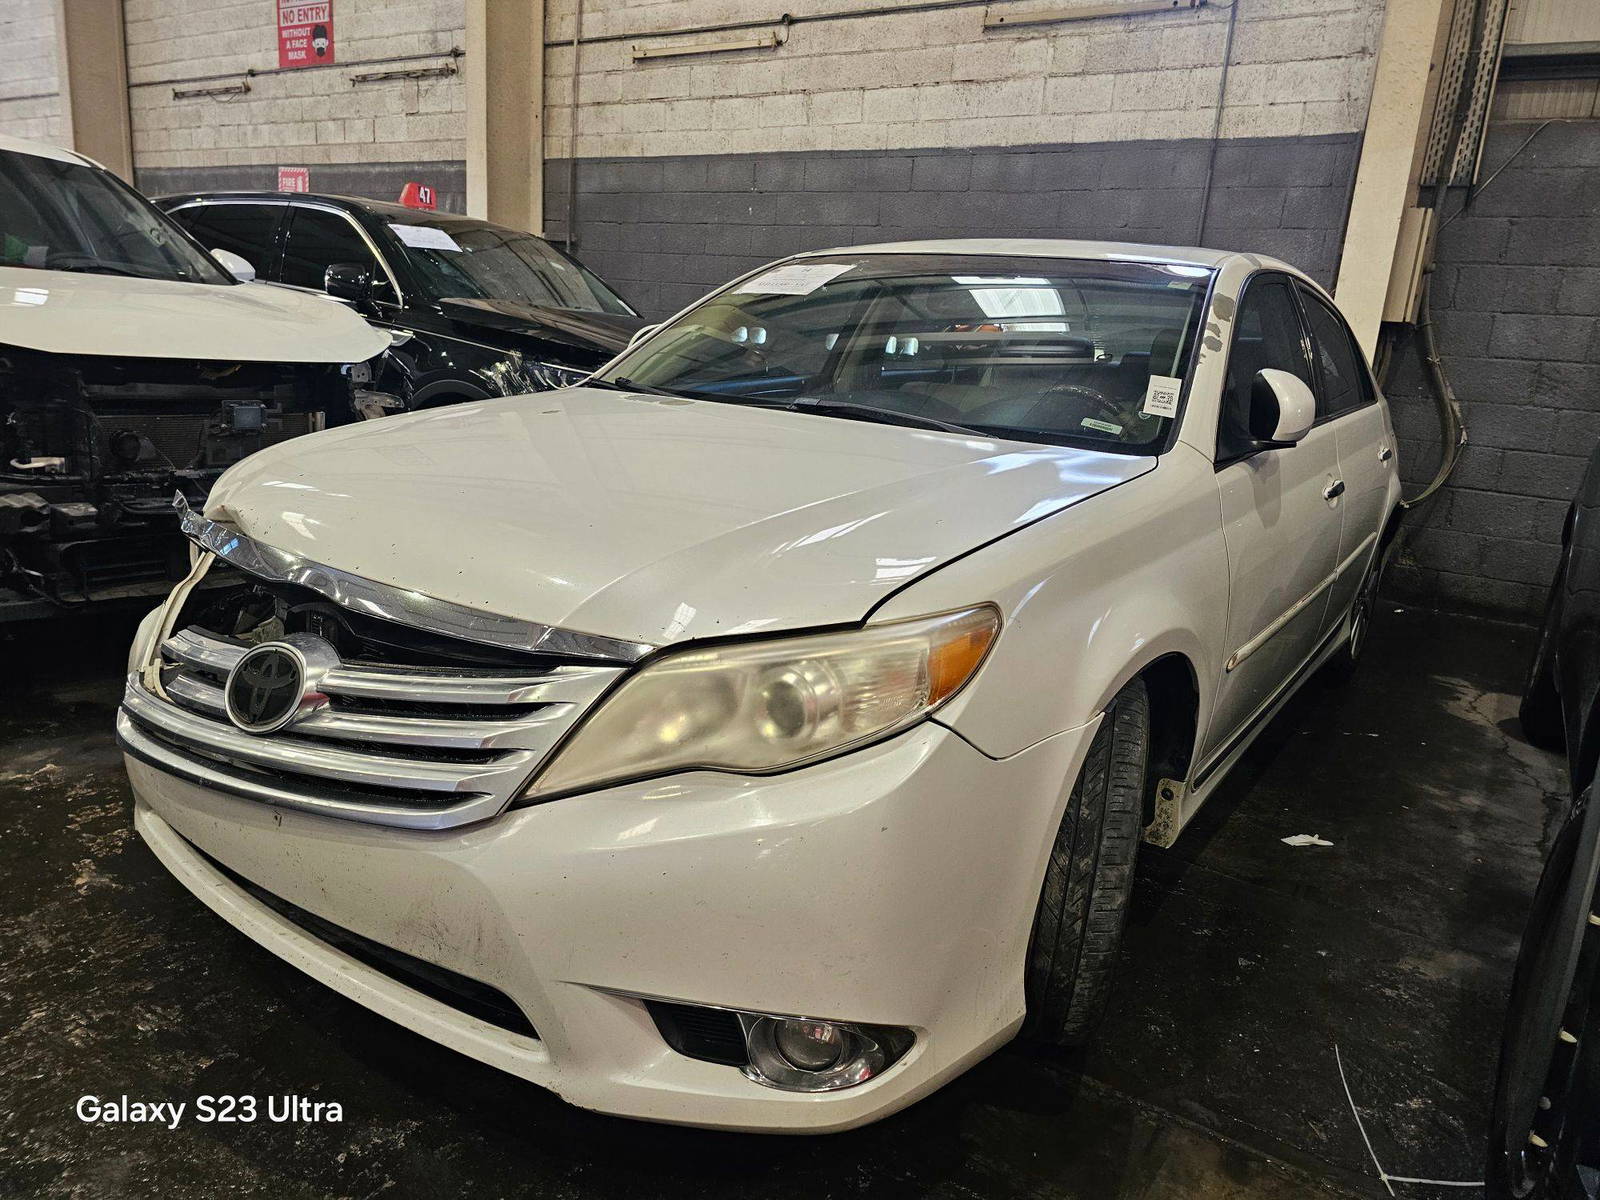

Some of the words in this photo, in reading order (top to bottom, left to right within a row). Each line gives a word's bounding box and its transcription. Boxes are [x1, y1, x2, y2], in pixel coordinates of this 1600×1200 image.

[282, 10, 294, 24] NO
[298, 5, 327, 22] ENTRY
[282, 27, 311, 38] WITHOUT
[292, 39, 308, 48] FACE
[288, 50, 307, 60] MASK
[282, 177, 296, 186] FIRE
[419, 186, 431, 204] 47
